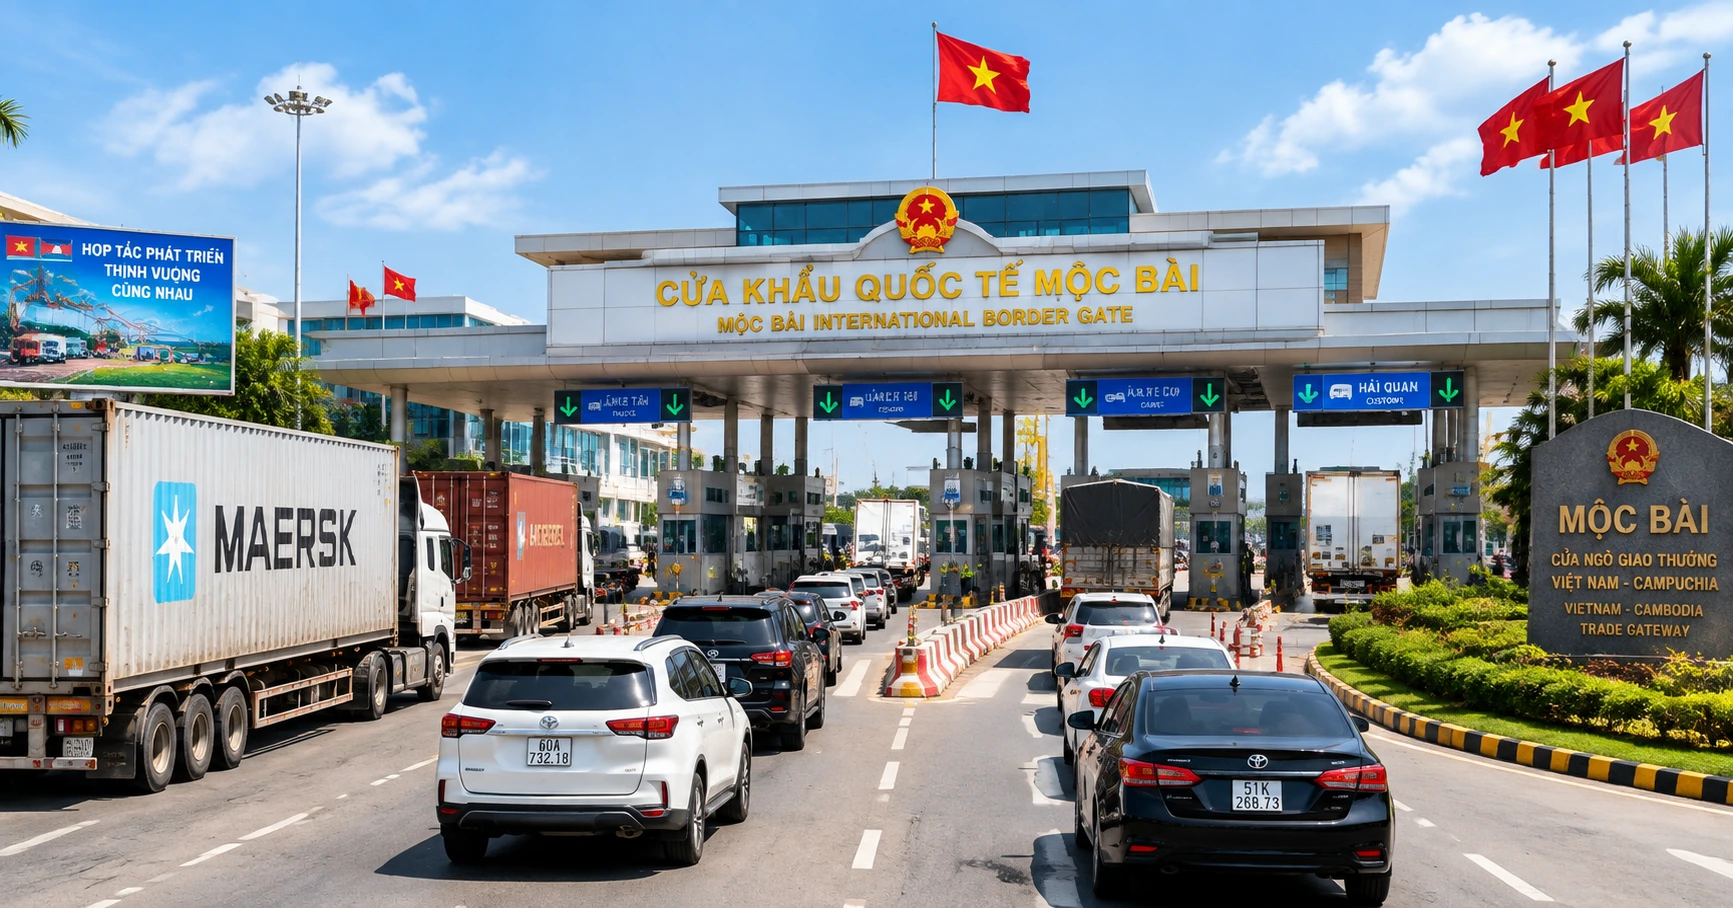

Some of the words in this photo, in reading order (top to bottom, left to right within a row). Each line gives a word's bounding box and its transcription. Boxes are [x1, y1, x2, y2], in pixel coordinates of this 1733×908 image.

[656, 270, 729, 307] CỬA
[743, 264, 840, 304] KHẨU
[855, 261, 963, 303] QUỐC
[975, 259, 1024, 298] TẾ
[1034, 260, 1120, 301] MỘC
[1135, 257, 1199, 293] BÀI
[155, 286, 193, 301] NHAU
[718, 312, 763, 336] MỘC
[814, 310, 976, 330] INTERNATIONAL
[983, 308, 1069, 327] BORDER
[1077, 306, 1134, 324] GATE
[1384, 381, 1418, 393] QUAN
[1559, 498, 1637, 540] MỘC
[1650, 498, 1709, 534] BÀI
[214, 504, 357, 573] MAERSK
[1551, 548, 1580, 567] CỬA
[1618, 553, 1653, 567] GIAO
[1587, 575, 1619, 590] NAM
[1633, 575, 1719, 591] CAMPUCHIA
[1564, 602, 1621, 616] VIETNAM
[1634, 603, 1703, 617] CAMBODIA
[1580, 623, 1623, 636] TRADE
[1627, 624, 1690, 637] GATEWAY
[539, 739, 560, 752] 60A
[529, 752, 569, 764] 732.18
[1244, 781, 1270, 796] 51K
[1236, 796, 1280, 810] 268.73
